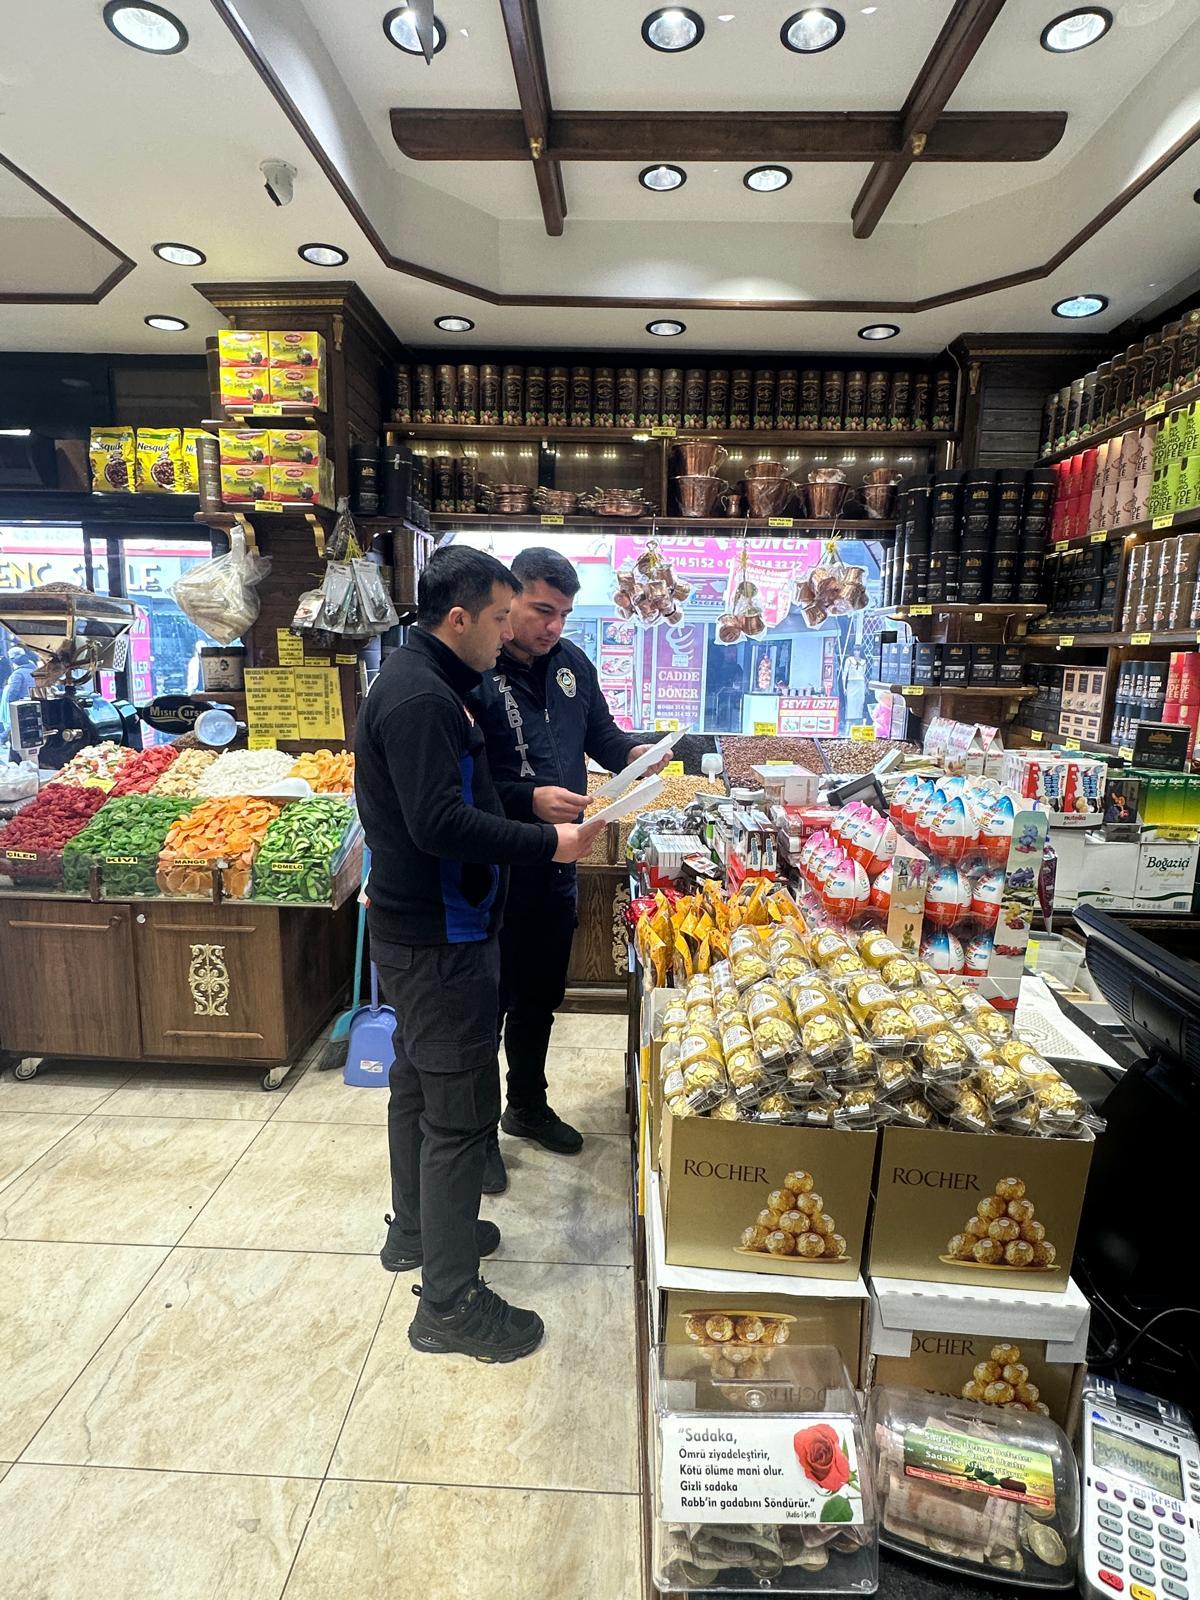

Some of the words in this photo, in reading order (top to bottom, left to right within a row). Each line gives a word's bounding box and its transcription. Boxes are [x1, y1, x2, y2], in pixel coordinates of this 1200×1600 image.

[658, 670, 700, 682] CADDE
[658, 685, 699, 698] DÖNER
[812, 700, 838, 710] USTA
[493, 675, 535, 777] ZABITA
[1147, 856, 1191, 871] Boğaziçi
[683, 1158, 770, 1185] ROCHER
[891, 1167, 981, 1192] ROCHER
[910, 1335, 977, 1358] OCHER
[679, 1448, 706, 1459] Ömrü
[708, 1448, 770, 1461] ziyadeleştirir,
[680, 1464, 702, 1476] Kötü
[705, 1464, 734, 1476] ölüme
[737, 1465, 760, 1476] mani
[763, 1465, 785, 1476] olur.
[680, 1480, 702, 1491] Gizli
[704, 1480, 738, 1491] sadaka
[720, 1497, 762, 1510] gadabını
